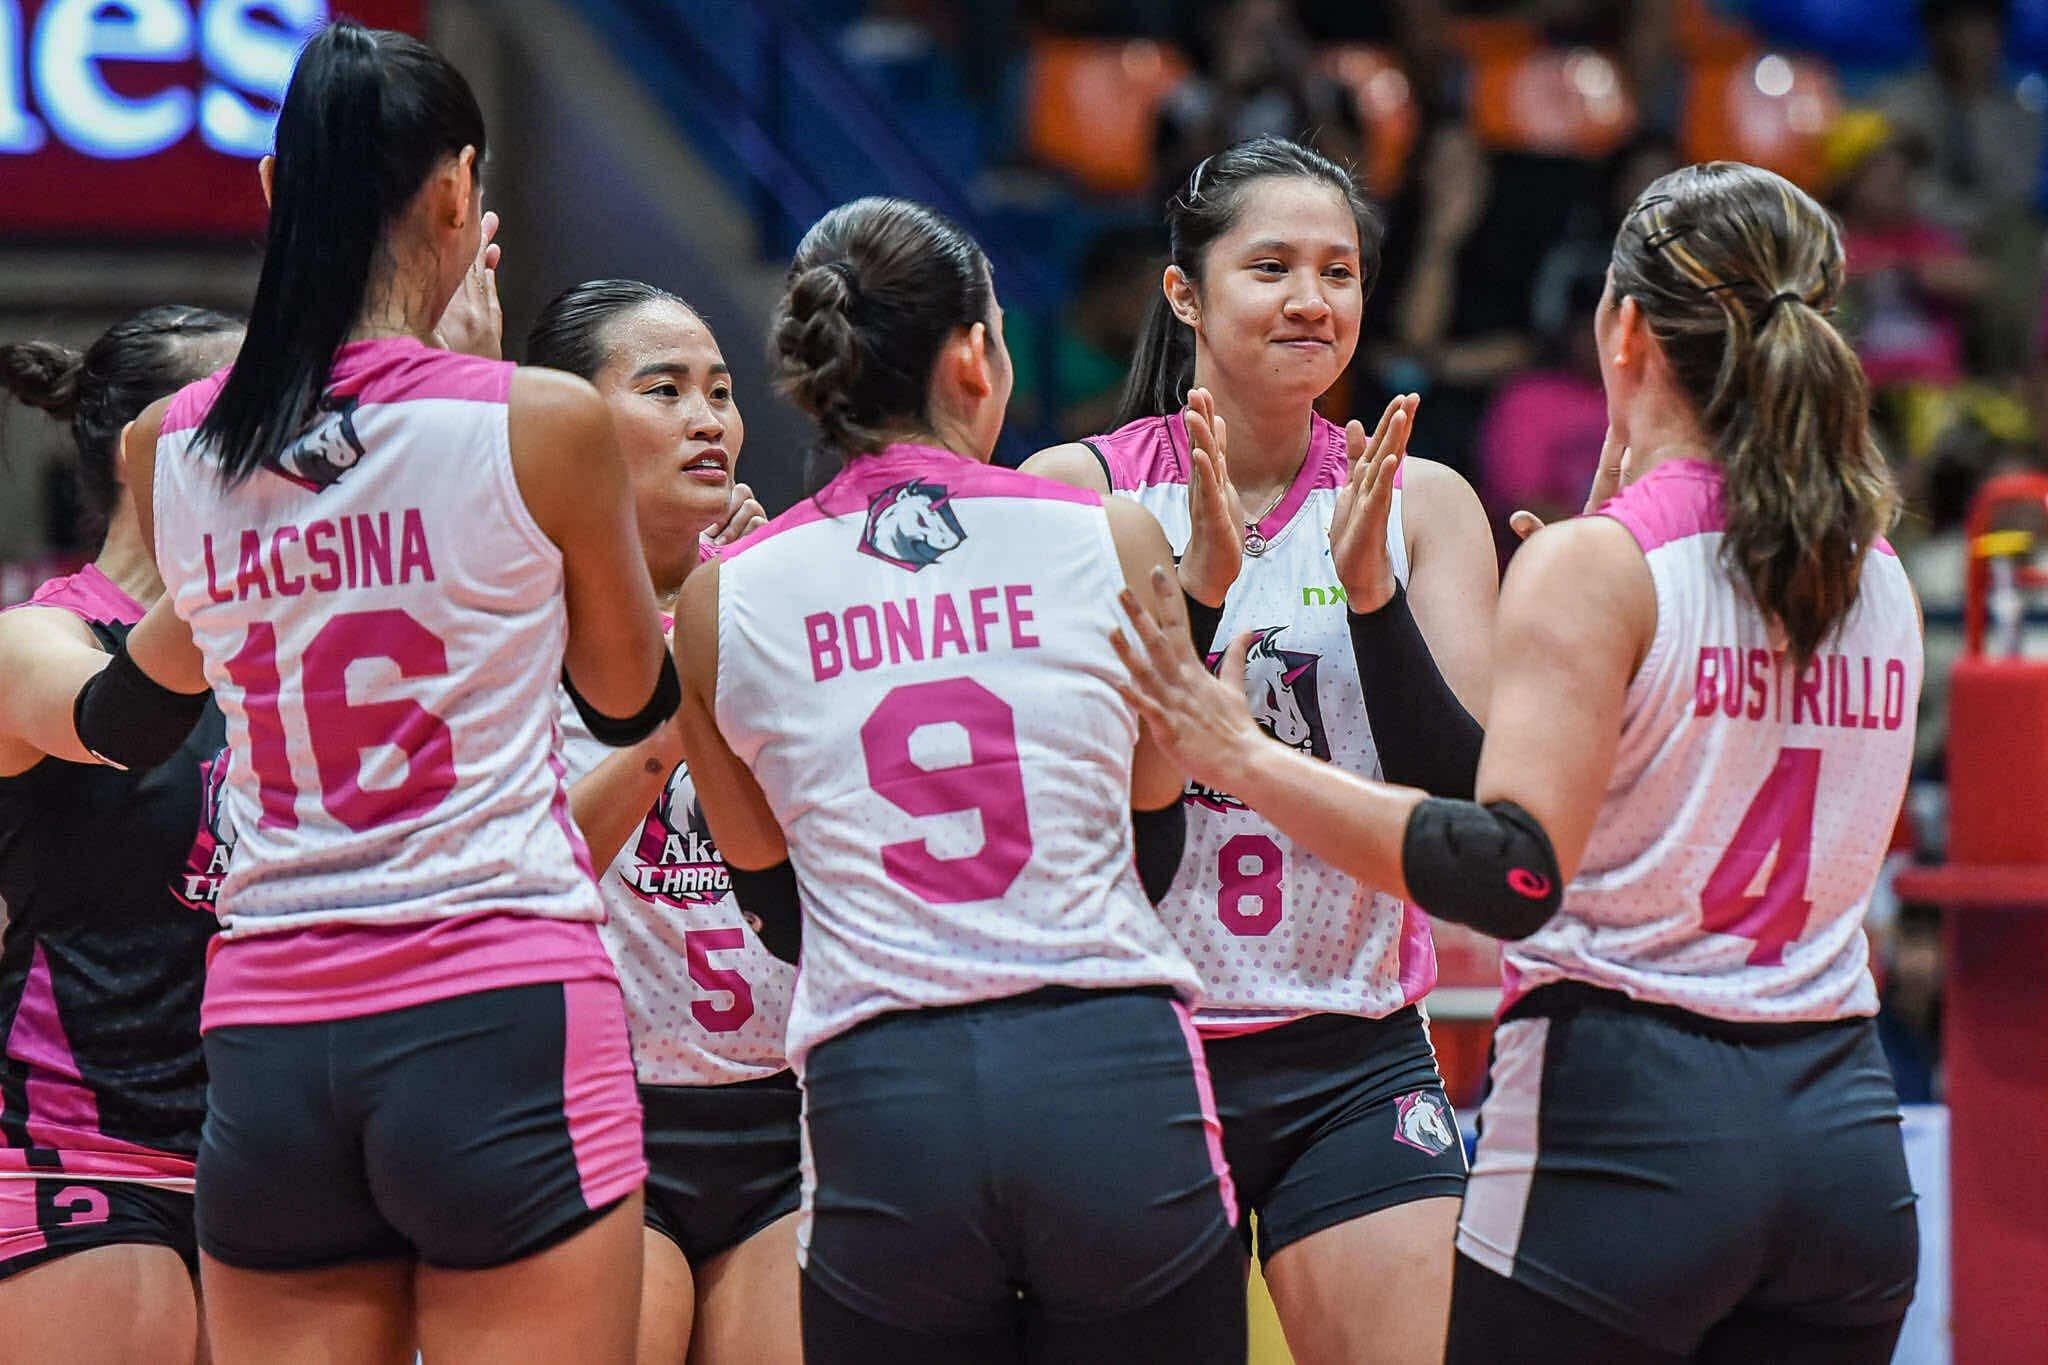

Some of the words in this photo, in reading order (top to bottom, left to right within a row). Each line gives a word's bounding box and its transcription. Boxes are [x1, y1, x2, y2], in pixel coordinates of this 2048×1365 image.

[203, 508, 436, 603] LACSINA
[804, 584, 1041, 683] BONAFE
[223, 607, 458, 834] 16
[1694, 645, 1905, 731] BUSTRILLO
[859, 676, 1033, 904] 9
[637, 866, 733, 893] CHARG
[1217, 834, 1284, 937] 8
[1699, 746, 1823, 967] 4
[684, 927, 755, 1033] 5
